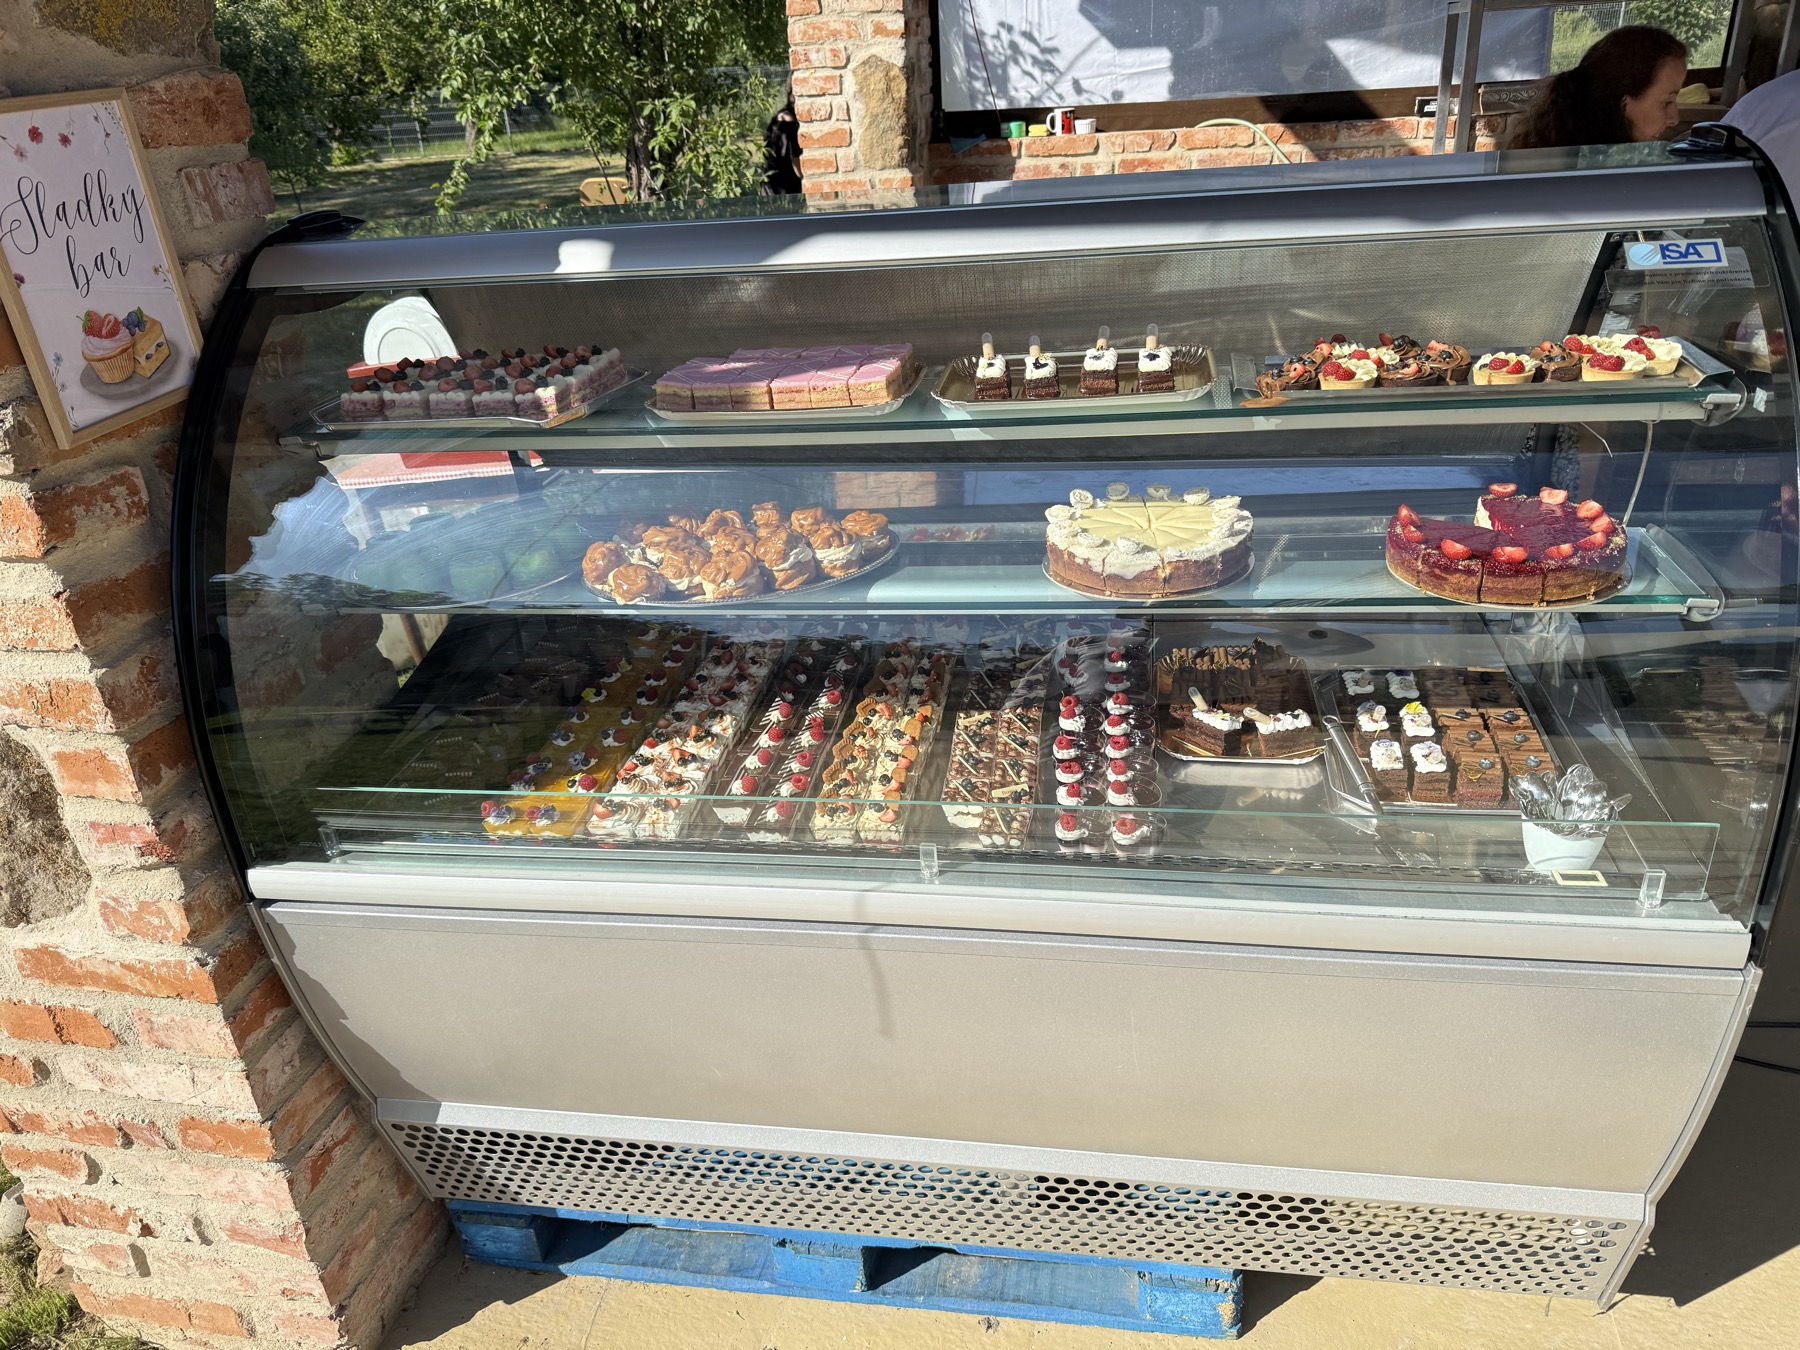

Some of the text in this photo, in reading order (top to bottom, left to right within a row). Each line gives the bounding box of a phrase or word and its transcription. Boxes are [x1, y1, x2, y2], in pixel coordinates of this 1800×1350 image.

[0, 169, 146, 255] Sladký
[66, 235, 131, 298] bar
[1658, 243, 1704, 260] ISA
